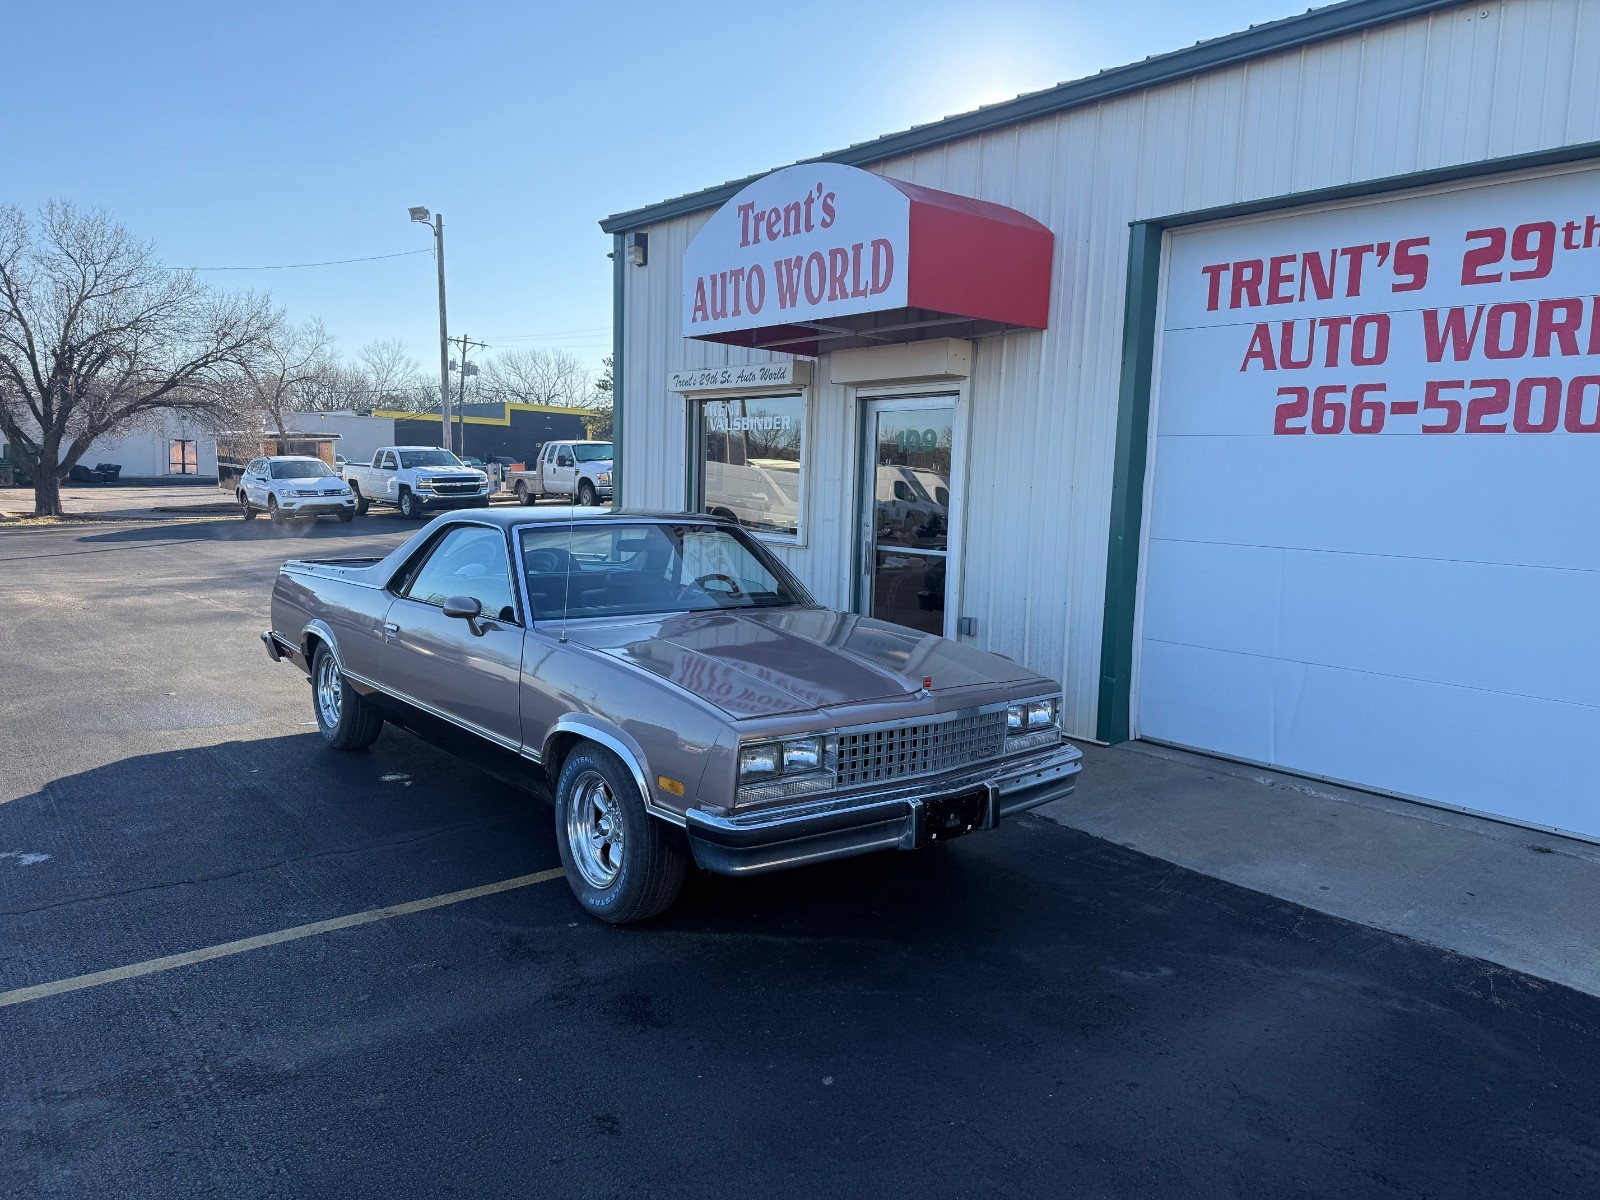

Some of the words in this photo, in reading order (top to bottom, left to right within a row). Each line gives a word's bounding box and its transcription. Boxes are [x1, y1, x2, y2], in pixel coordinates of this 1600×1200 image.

[738, 182, 836, 248] Trent's
[691, 264, 766, 323] AUTO
[774, 238, 895, 310] WORLD
[1201, 236, 1430, 311] TRENT'S
[1240, 313, 1391, 372] AUTO
[1422, 296, 1600, 363] WOR
[673, 373, 697, 388] Trent's
[700, 371, 719, 386] 29th
[720, 370, 733, 384] St.
[735, 369, 756, 384] Auto
[760, 366, 788, 381] World
[1274, 375, 1600, 435] 266-5200
[702, 401, 742, 417] TRENT
[896, 428, 938, 453] 109
